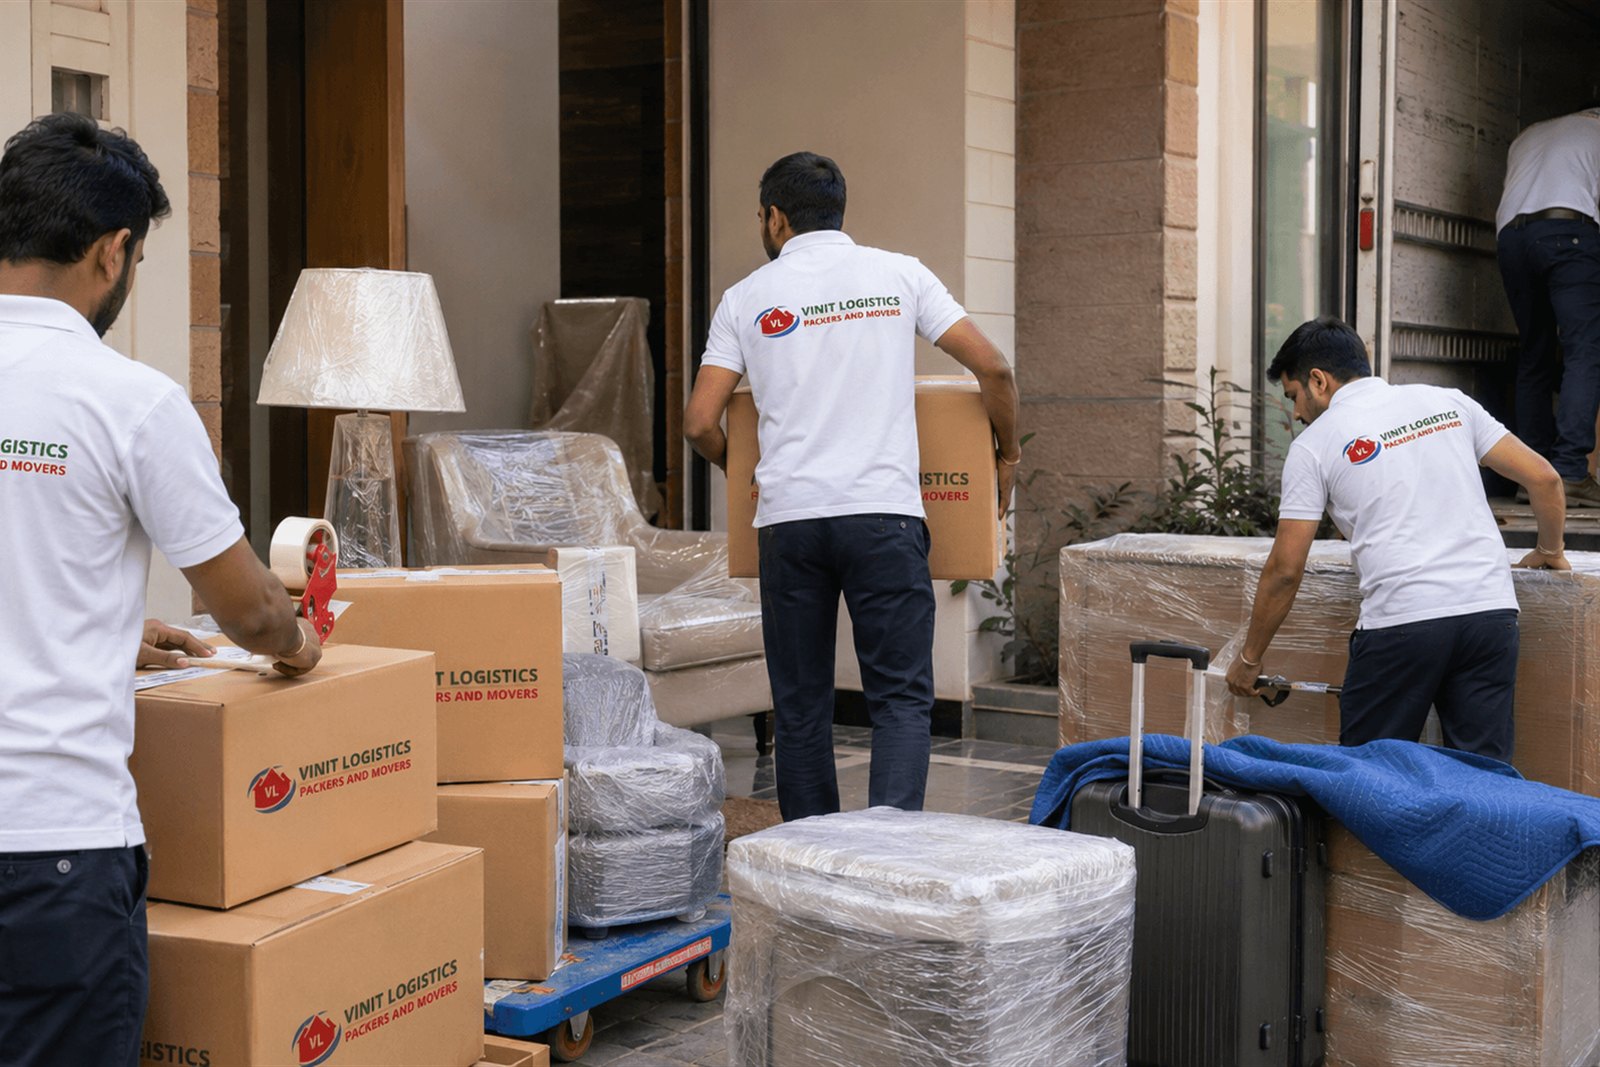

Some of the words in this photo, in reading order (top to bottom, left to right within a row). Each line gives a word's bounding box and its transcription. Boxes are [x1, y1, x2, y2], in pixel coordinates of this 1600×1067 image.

[801, 302, 836, 316] VINIT
[839, 296, 901, 311] LOGISTICS
[770, 318, 784, 329] VL
[803, 315, 843, 327] PACKERS
[844, 312, 864, 321] AND
[866, 308, 901, 319] MOVERS
[1380, 425, 1408, 441] VINIT
[1409, 410, 1459, 431] LOGISTICS
[1, 438, 69, 459] GISTICS
[1355, 448, 1368, 457] VL
[11, 460, 67, 476] MOVERS
[919, 472, 969, 486] ISTICS
[449, 668, 539, 685] LOGISTICS
[454, 690, 483, 702] AND
[487, 688, 539, 700] MOVERS
[299, 757, 339, 781] VINIT
[342, 739, 412, 770] LOGISTICS
[299, 776, 345, 798] PACKERS
[346, 769, 369, 785] AND
[371, 758, 412, 779] MOVERS
[264, 785, 280, 799] VL
[344, 992, 384, 1024] VINIT
[387, 959, 458, 1005] LOGISTICS
[344, 1012, 390, 1043] PACKERS
[391, 1001, 415, 1021] AND
[417, 980, 458, 1008] MOVERS
[308, 1033, 325, 1050] VL
[140, 1040, 211, 1067] ISTICS
